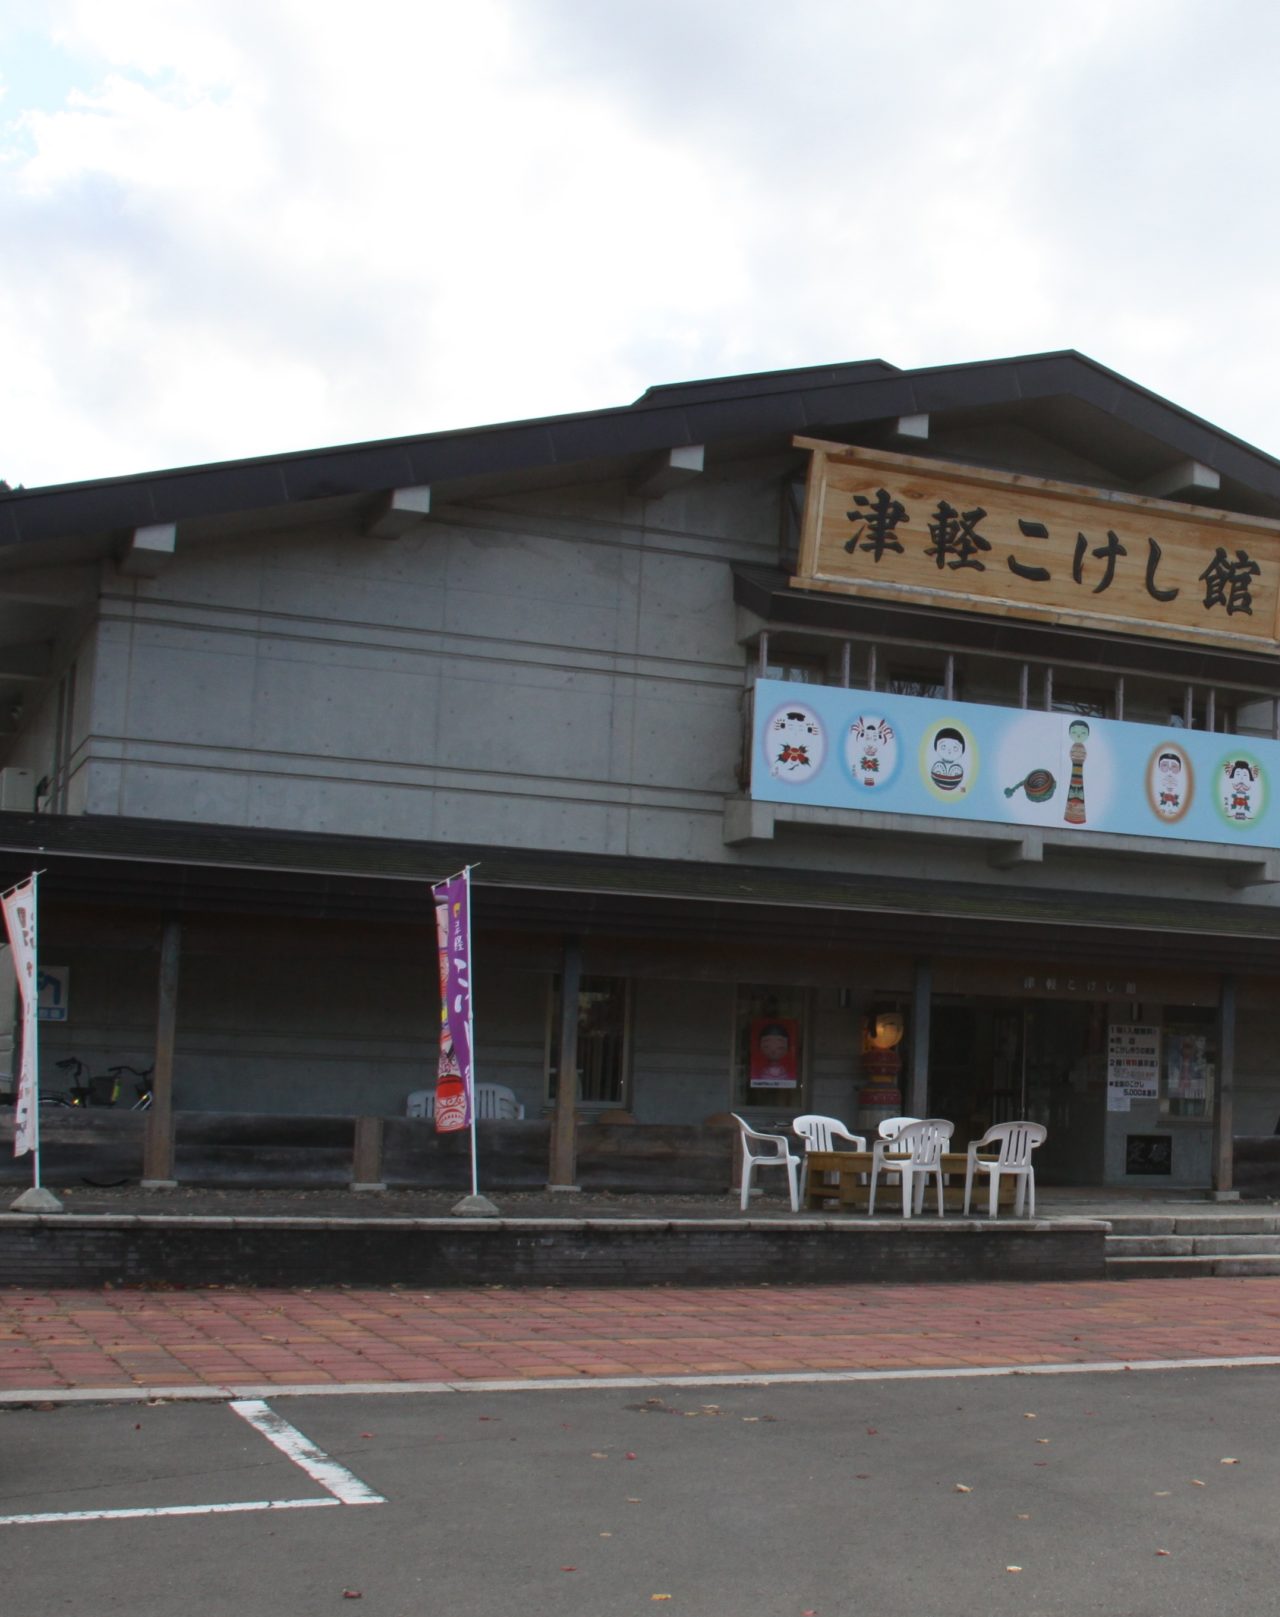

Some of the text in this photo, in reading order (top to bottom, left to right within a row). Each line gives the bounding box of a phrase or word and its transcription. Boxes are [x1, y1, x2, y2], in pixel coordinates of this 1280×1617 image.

[843, 488, 1261, 617] 津軽こけし館
